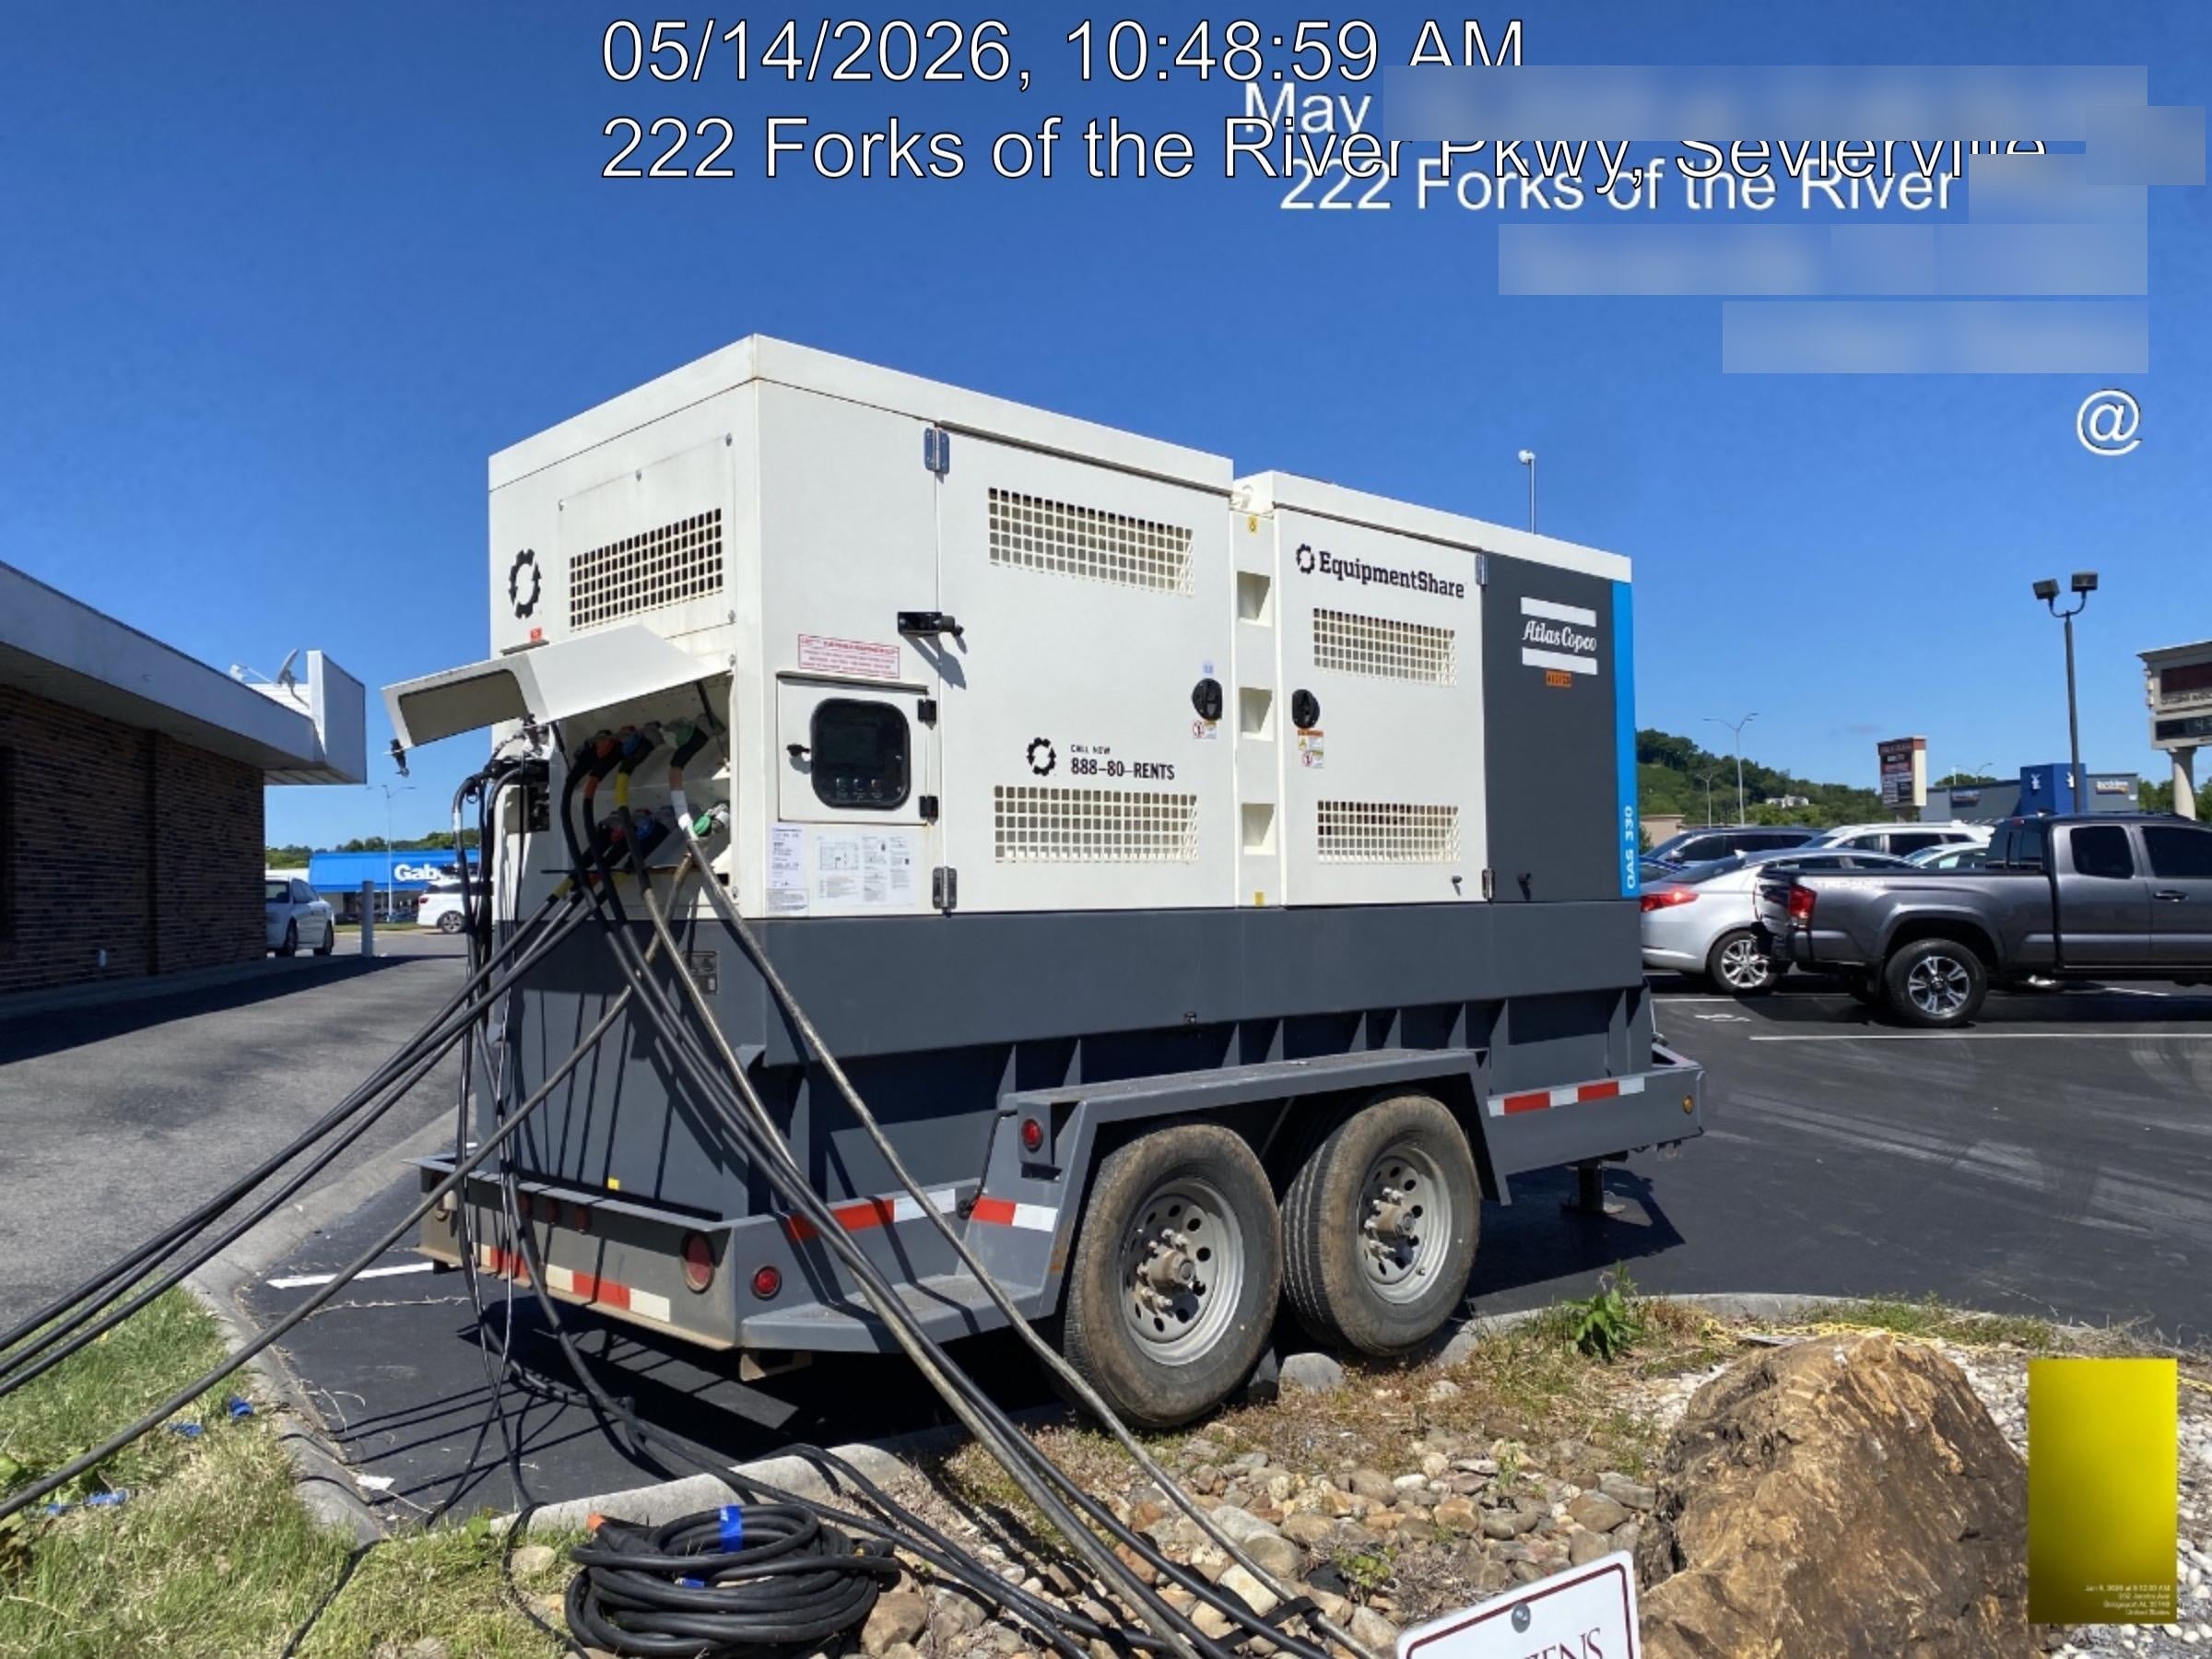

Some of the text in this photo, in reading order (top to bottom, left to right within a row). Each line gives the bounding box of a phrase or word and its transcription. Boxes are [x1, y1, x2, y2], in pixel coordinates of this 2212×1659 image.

[1318, 550, 1465, 599] EquipmentShare
[1522, 620, 1598, 653] Atlas Copco
[1071, 757, 1176, 781] 888-80-RENTS
[1623, 805, 1635, 841] 330
